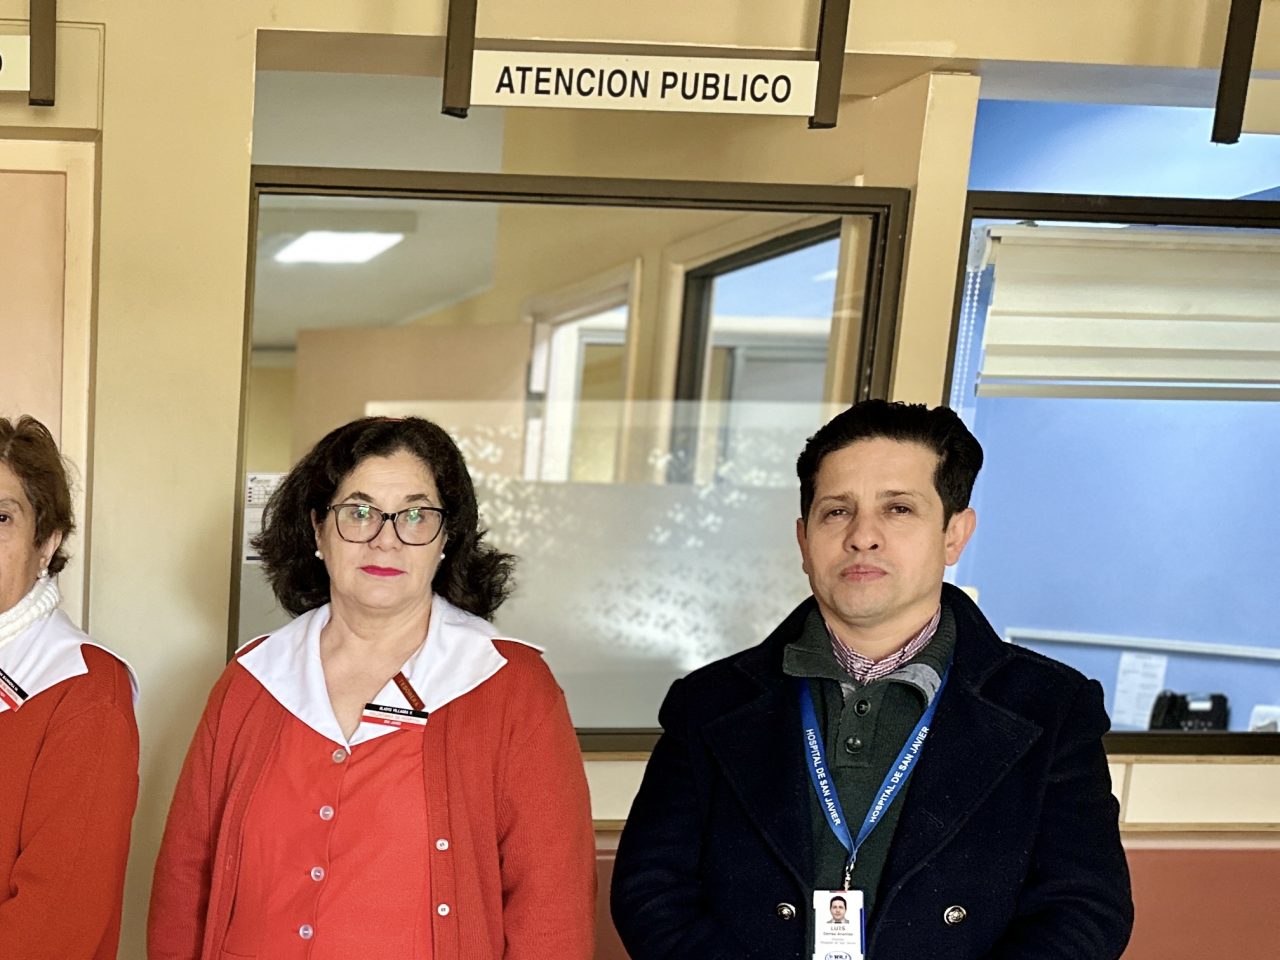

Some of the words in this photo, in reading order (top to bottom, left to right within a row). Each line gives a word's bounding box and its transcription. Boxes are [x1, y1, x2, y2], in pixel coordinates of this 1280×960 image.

[495, 66, 650, 98] ATENCION
[660, 71, 792, 103] PUBLICO
[806, 728, 821, 767] HOSPITAL
[815, 767, 825, 779] DE
[820, 779, 831, 797] SAN
[870, 783, 896, 823] HOSPITAL
[891, 771, 903, 784] DE
[899, 753, 914, 772] SAN
[912, 726, 930, 755] JAVIER
[825, 796, 841, 826] JAVIER
